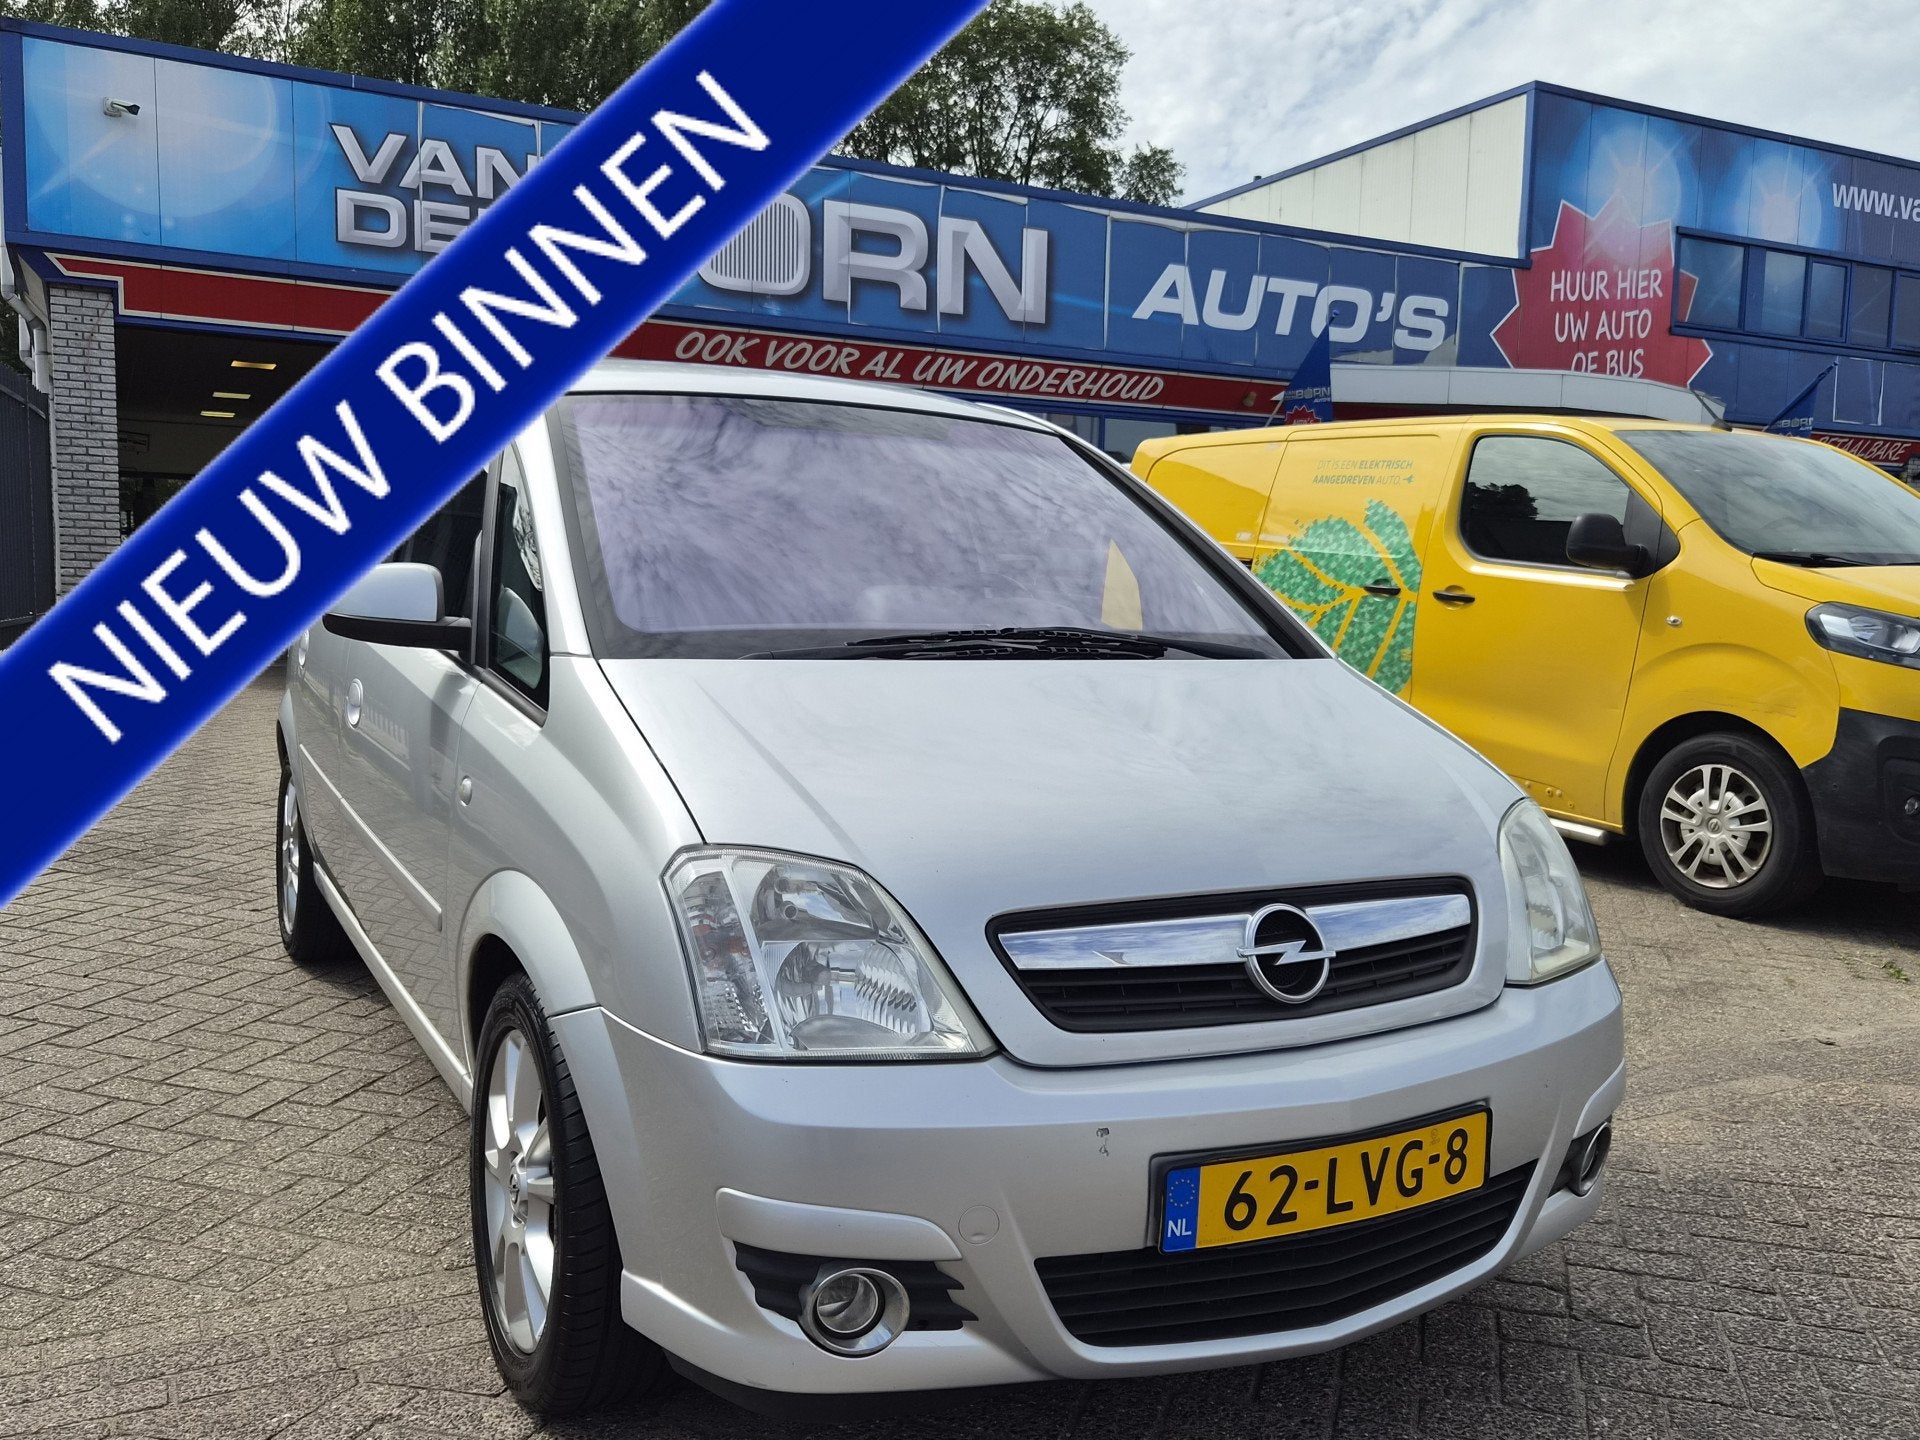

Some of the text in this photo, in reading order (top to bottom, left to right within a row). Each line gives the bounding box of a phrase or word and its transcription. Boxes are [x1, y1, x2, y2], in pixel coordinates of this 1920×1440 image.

[336, 187, 489, 252] DE
[698, 192, 1049, 324] ORN
[1550, 268, 1663, 302] HUUR HIER
[1131, 263, 1449, 351] AUTO'S
[1555, 308, 1651, 343] UW AUTO
[675, 331, 1164, 400] OOK VOOR AL UW ONDERHOUD
[1606, 348, 1645, 378] BUS
[1312, 475, 1375, 485] AANGEDREVEN
[1317, 460, 1413, 470] DIT IS EEN ELEKTRISCH
[1224, 1128, 1469, 1231] 62-LVG-8
[1167, 1218, 1192, 1238] NL
